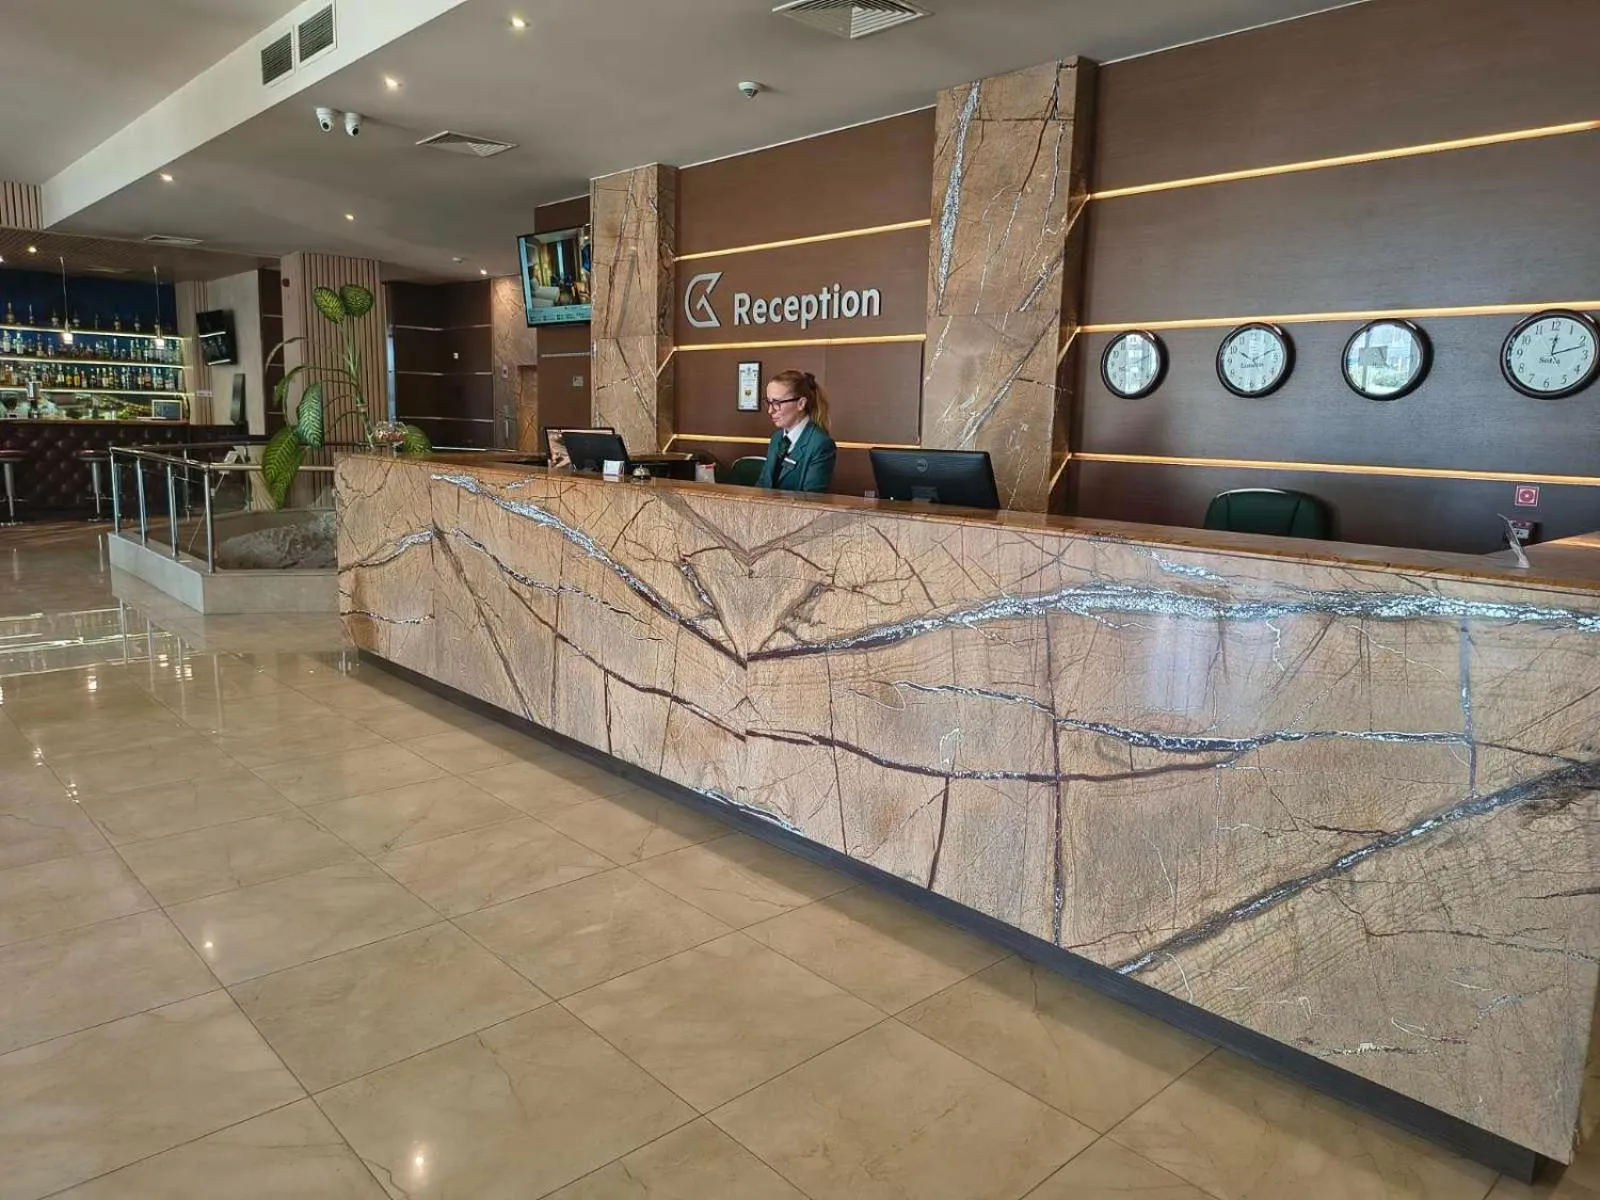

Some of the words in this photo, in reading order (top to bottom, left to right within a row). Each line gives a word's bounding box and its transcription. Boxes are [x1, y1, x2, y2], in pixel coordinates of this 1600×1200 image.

[734, 283, 880, 329] Reception
[1536, 324, 1543, 335] 11
[1552, 320, 1561, 331] 12
[1569, 324, 1574, 335] 1
[1522, 334, 1531, 345] 10
[1580, 335, 1586, 346] 2
[1230, 345, 1237, 354] 10
[1517, 349, 1523, 358] 9
[1581, 350, 1588, 360] 3
[1519, 362, 1524, 373] 8
[1573, 364, 1580, 374] 4
[1529, 373, 1535, 383] 7
[1543, 377, 1549, 388] 6
[1561, 374, 1567, 384] 5
